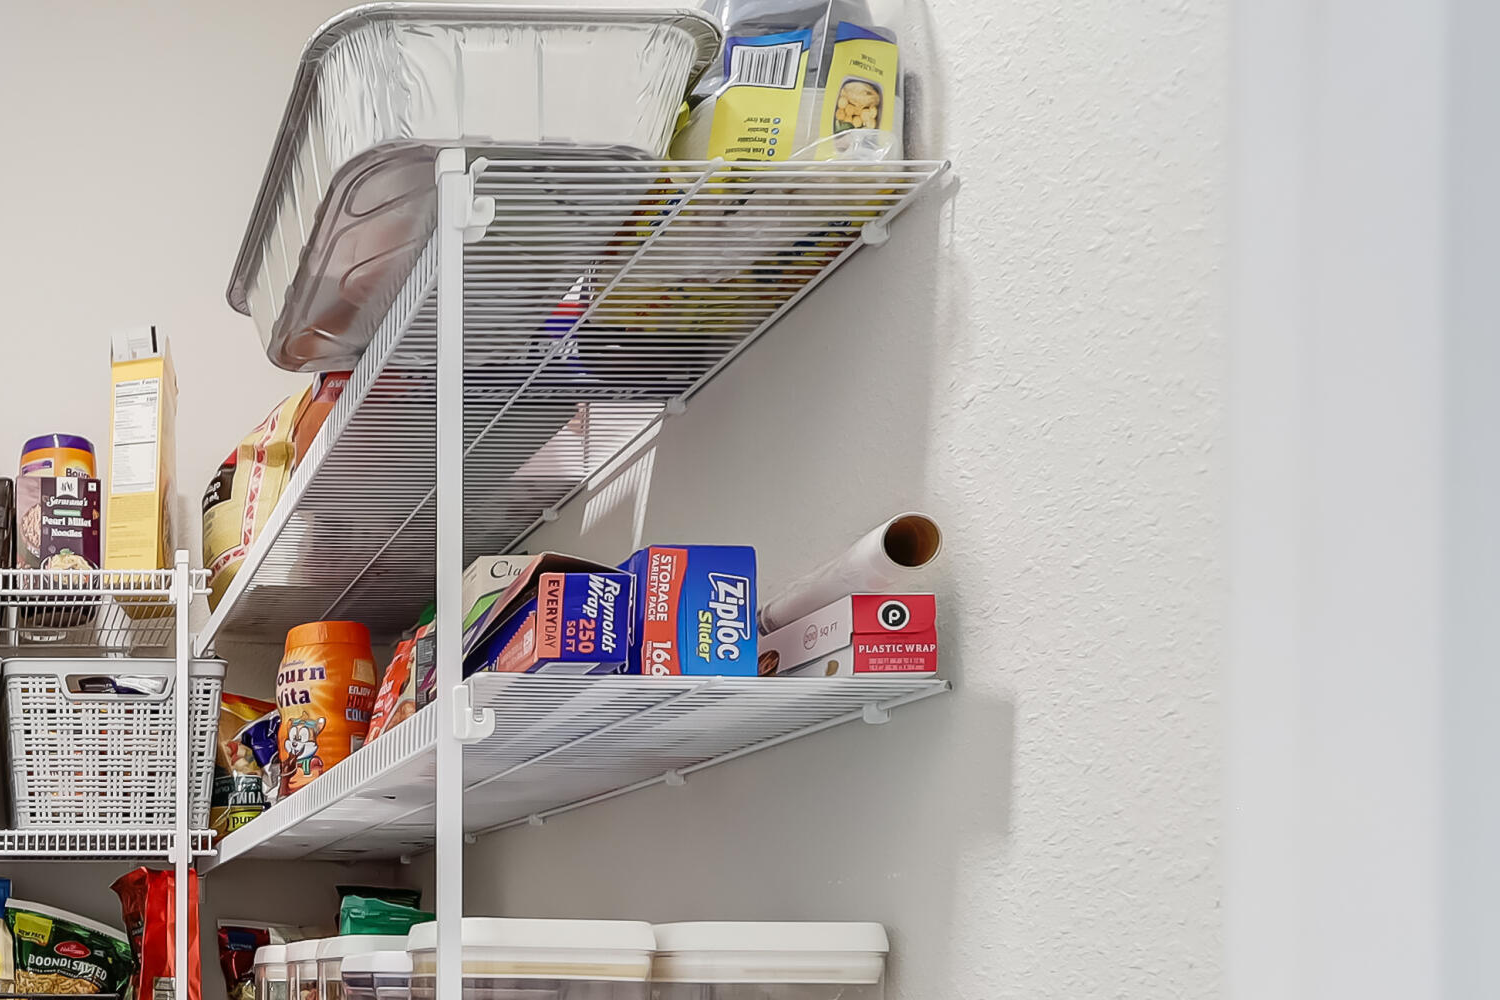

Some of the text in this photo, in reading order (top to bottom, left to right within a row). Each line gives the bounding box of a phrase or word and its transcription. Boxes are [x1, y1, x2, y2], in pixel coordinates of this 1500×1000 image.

[42, 515, 92, 527] Pearl Millet
[51, 528, 83, 538] Noodles
[581, 574, 604, 618] Wrap
[647, 553, 660, 622] VARIETY PACK
[656, 554, 672, 622] STORAGE
[544, 579, 560, 649] EVERYDAY
[599, 577, 621, 654] Reynolds
[708, 580, 745, 660] Ziploc
[819, 626, 828, 637] SQ
[829, 622, 838, 633] FT
[565, 620, 576, 653] SQ FT
[577, 618, 596, 654] 250
[697, 610, 713, 663] Slider
[858, 643, 937, 654] PLASTIC WRAP
[651, 640, 672, 677] 166
[28, 953, 71, 969] BOONDI
